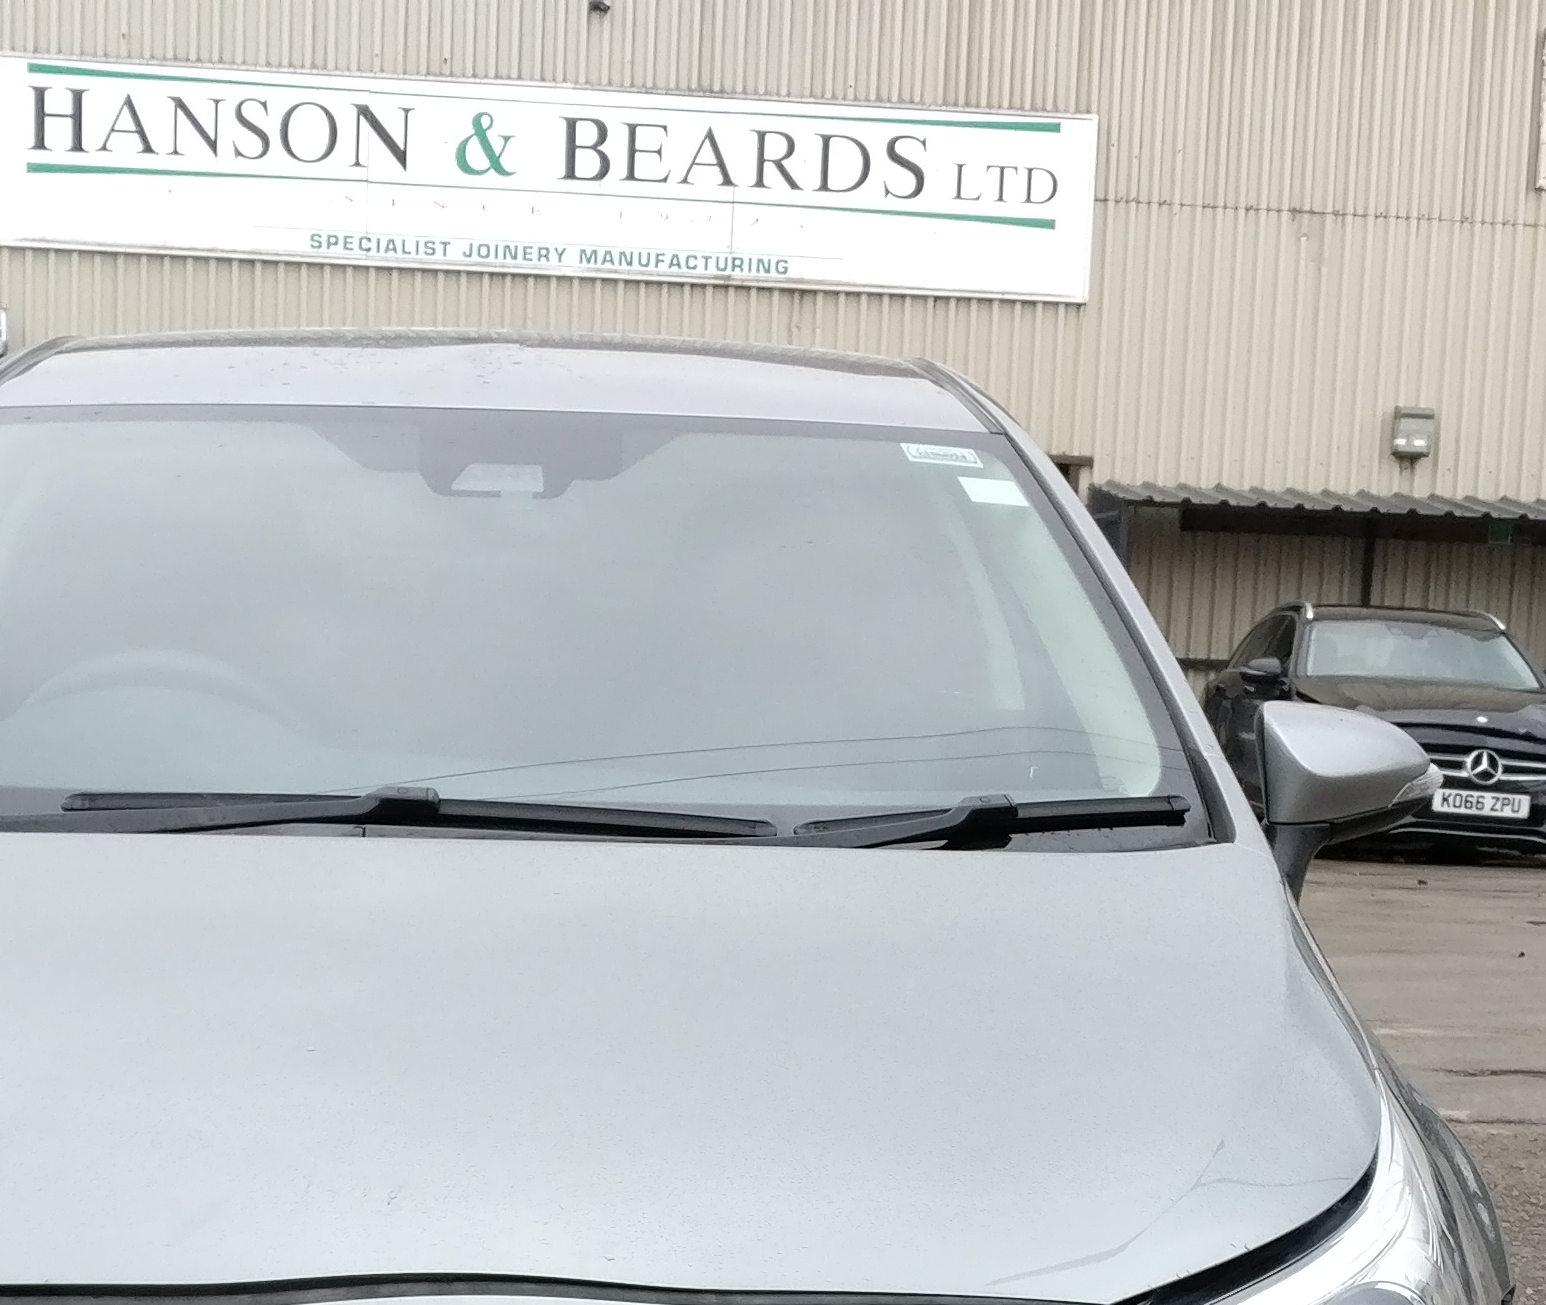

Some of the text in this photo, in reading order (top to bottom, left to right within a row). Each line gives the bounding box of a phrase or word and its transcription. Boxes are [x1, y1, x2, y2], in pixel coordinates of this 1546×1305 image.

[27, 84, 1059, 205] HANSON & BEARDS LTD
[309, 231, 791, 276] SPECIALIST JOINERY MANUFACTURING
[1440, 791, 1522, 814] KO66 ZPU
